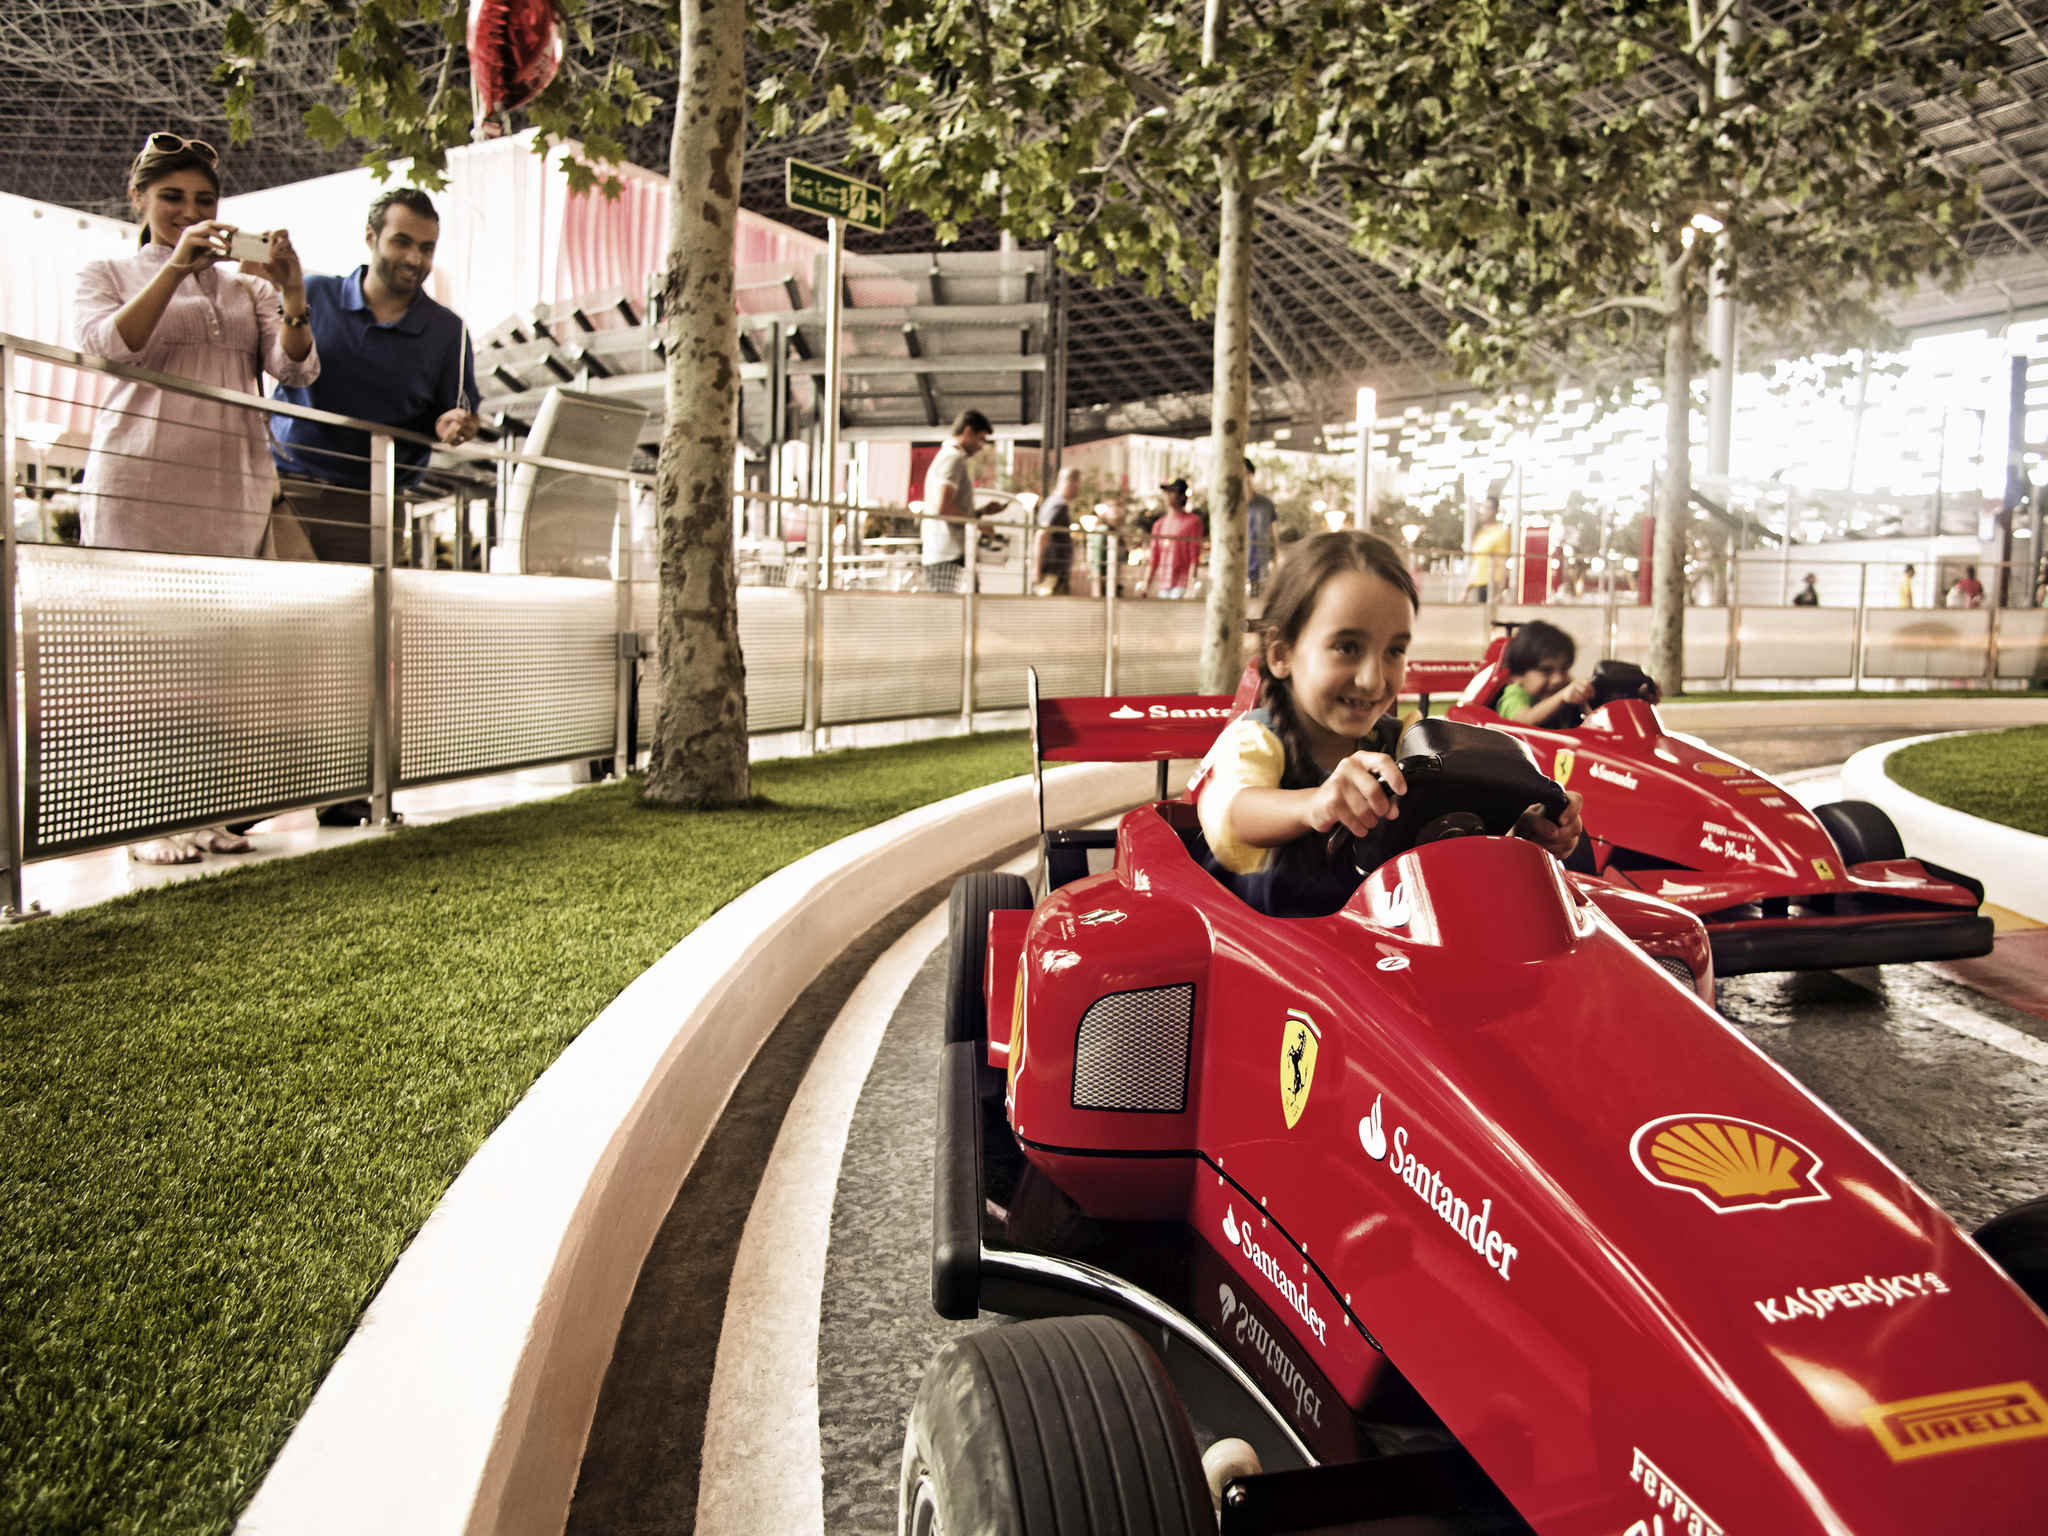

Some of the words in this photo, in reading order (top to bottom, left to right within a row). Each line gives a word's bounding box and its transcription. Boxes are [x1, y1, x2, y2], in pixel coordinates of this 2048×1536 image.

[1389, 1125, 1519, 1281] Santander
[1241, 1220, 1327, 1347] Santander
[1754, 1274, 1929, 1323] KASPERSKY
[1882, 1395, 2043, 1446] PIRELLI
